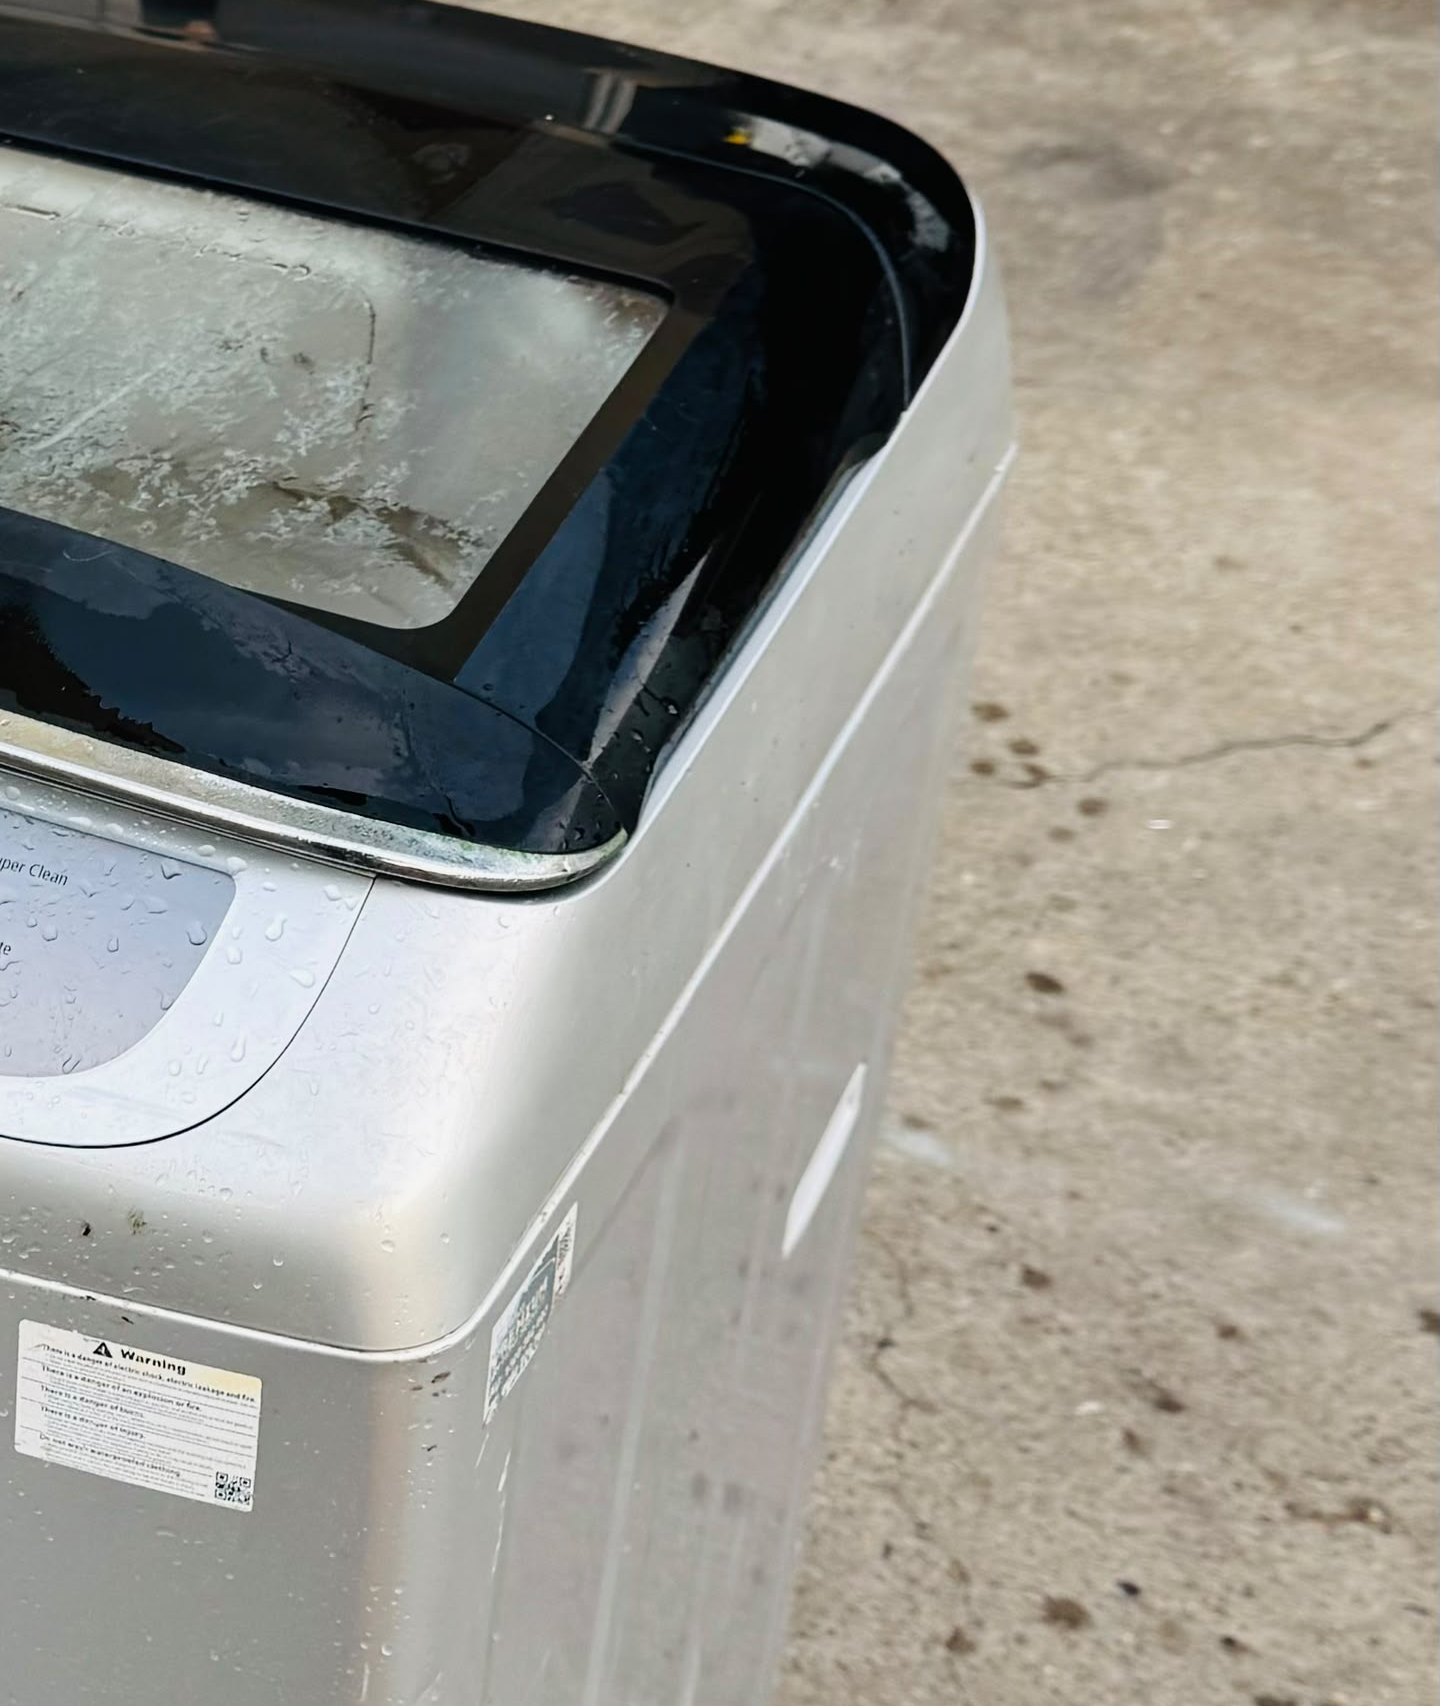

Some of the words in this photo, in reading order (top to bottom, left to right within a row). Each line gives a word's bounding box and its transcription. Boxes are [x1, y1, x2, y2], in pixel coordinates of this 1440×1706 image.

[28, 863, 68, 886] Clean
[120, 1349, 186, 1375] Warning
[41, 1363, 64, 1376] There
[41, 1384, 63, 1397] There
[41, 1405, 63, 1417] There
